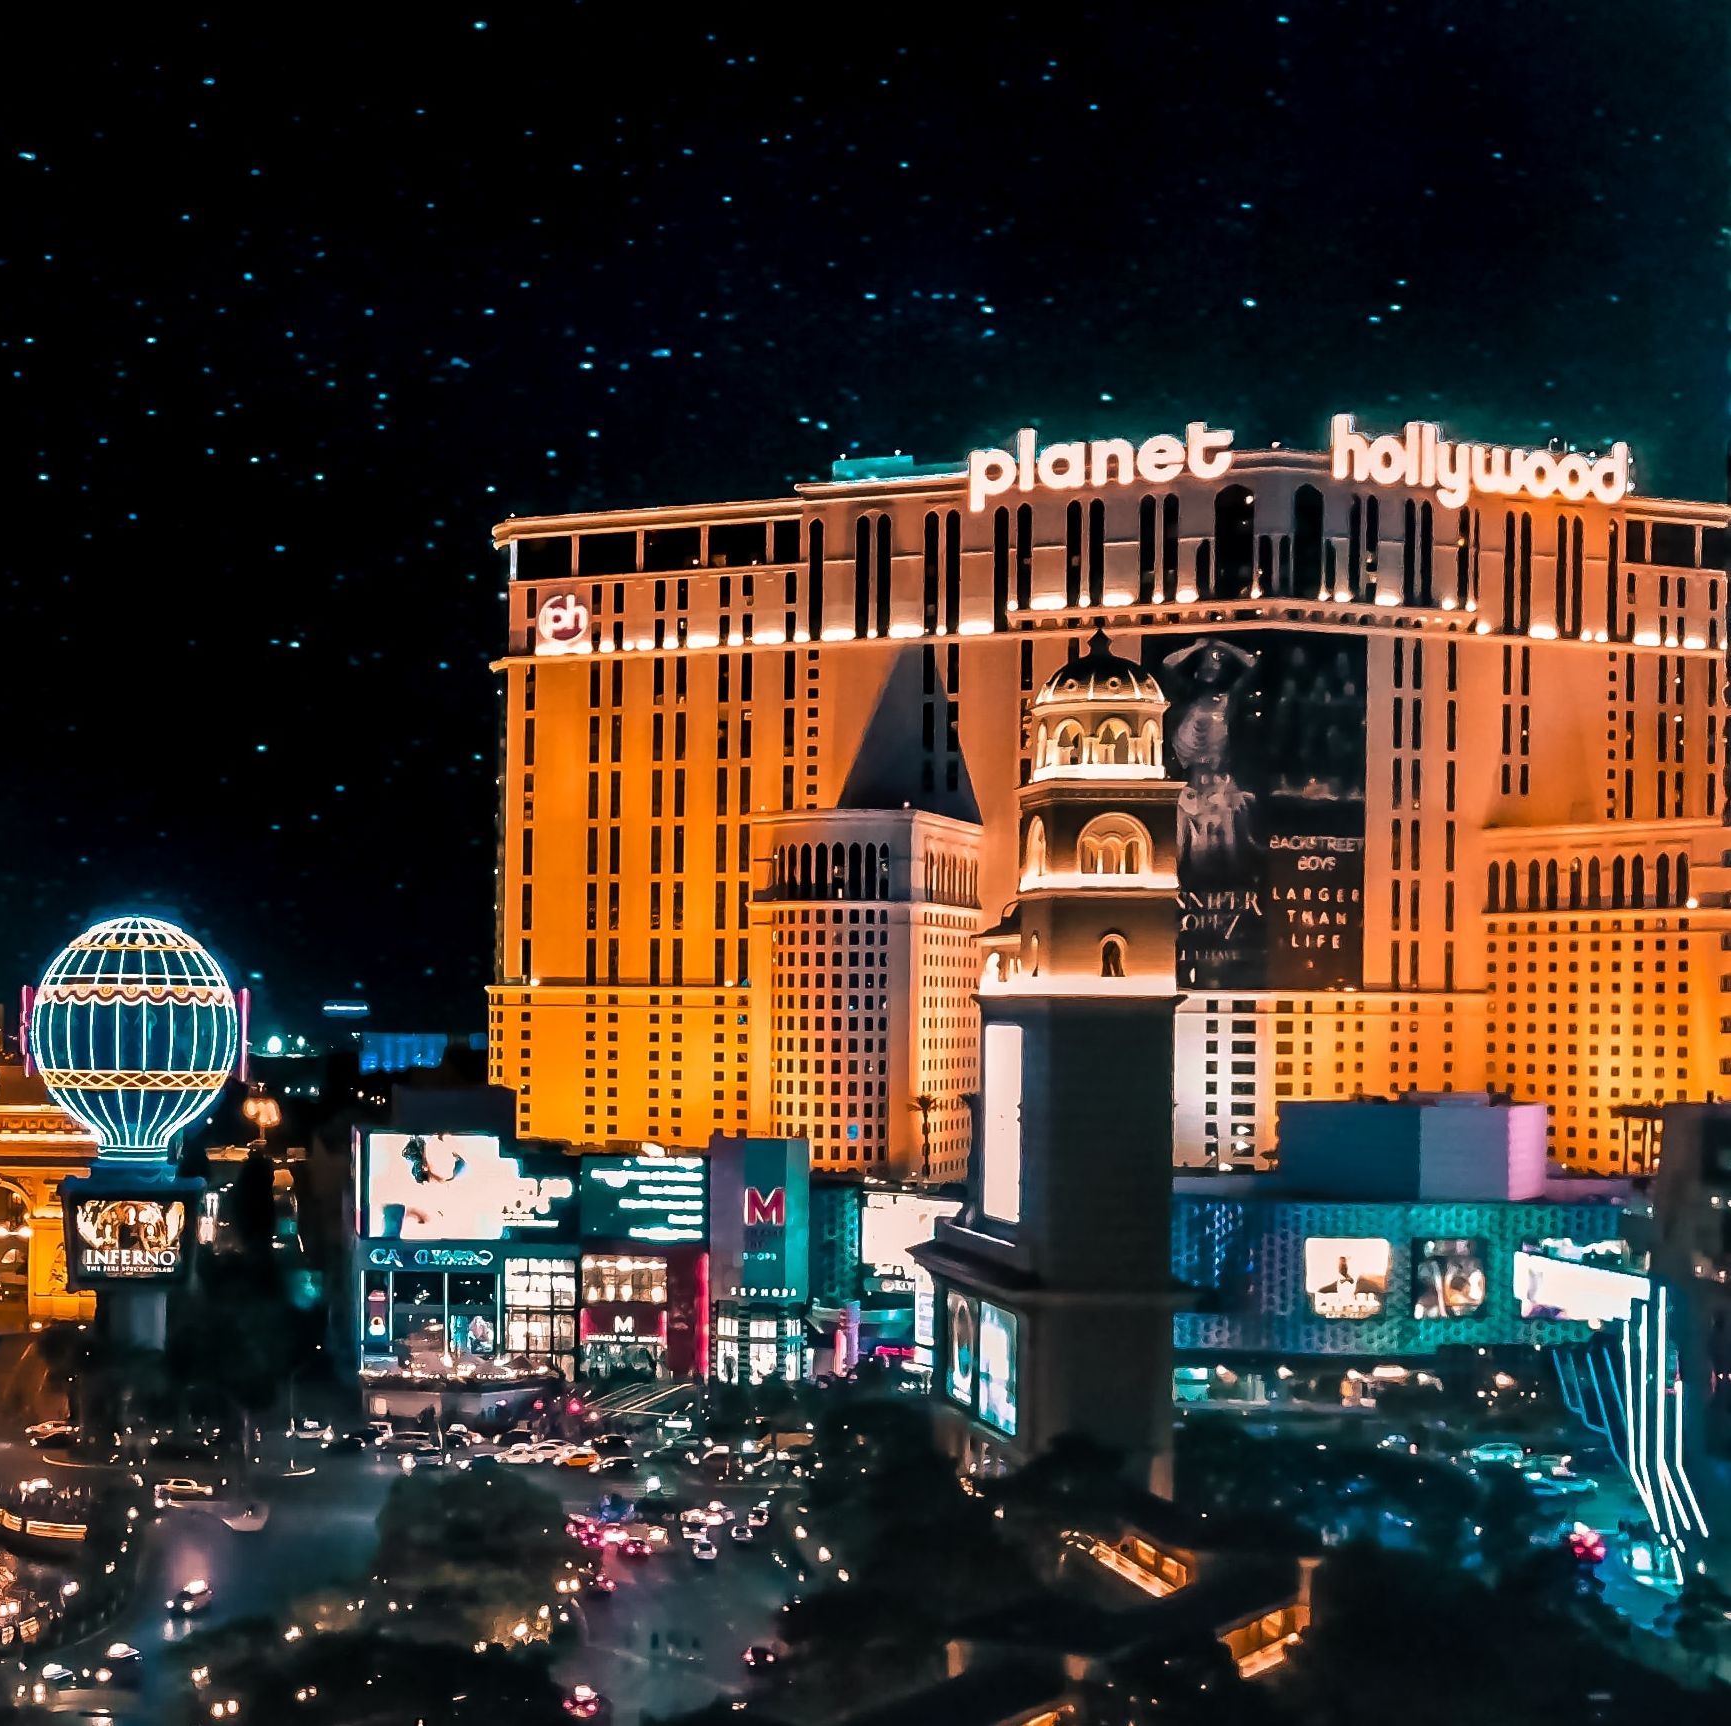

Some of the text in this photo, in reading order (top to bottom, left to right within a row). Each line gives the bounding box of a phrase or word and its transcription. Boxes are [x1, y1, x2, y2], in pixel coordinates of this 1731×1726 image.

[969, 413, 1628, 513] planet hollywood
[1270, 835, 1364, 851] BACKSTREET
[1297, 856, 1337, 871] BOYS
[1272, 886, 1360, 903] LARGER
[1287, 909, 1347, 927] THAN
[1291, 933, 1341, 949] LIFE
[744, 1186, 786, 1226] M
[86, 1249, 176, 1266] INFERNO
[730, 1286, 797, 1297] SEPHORA
[614, 1315, 635, 1333] M
